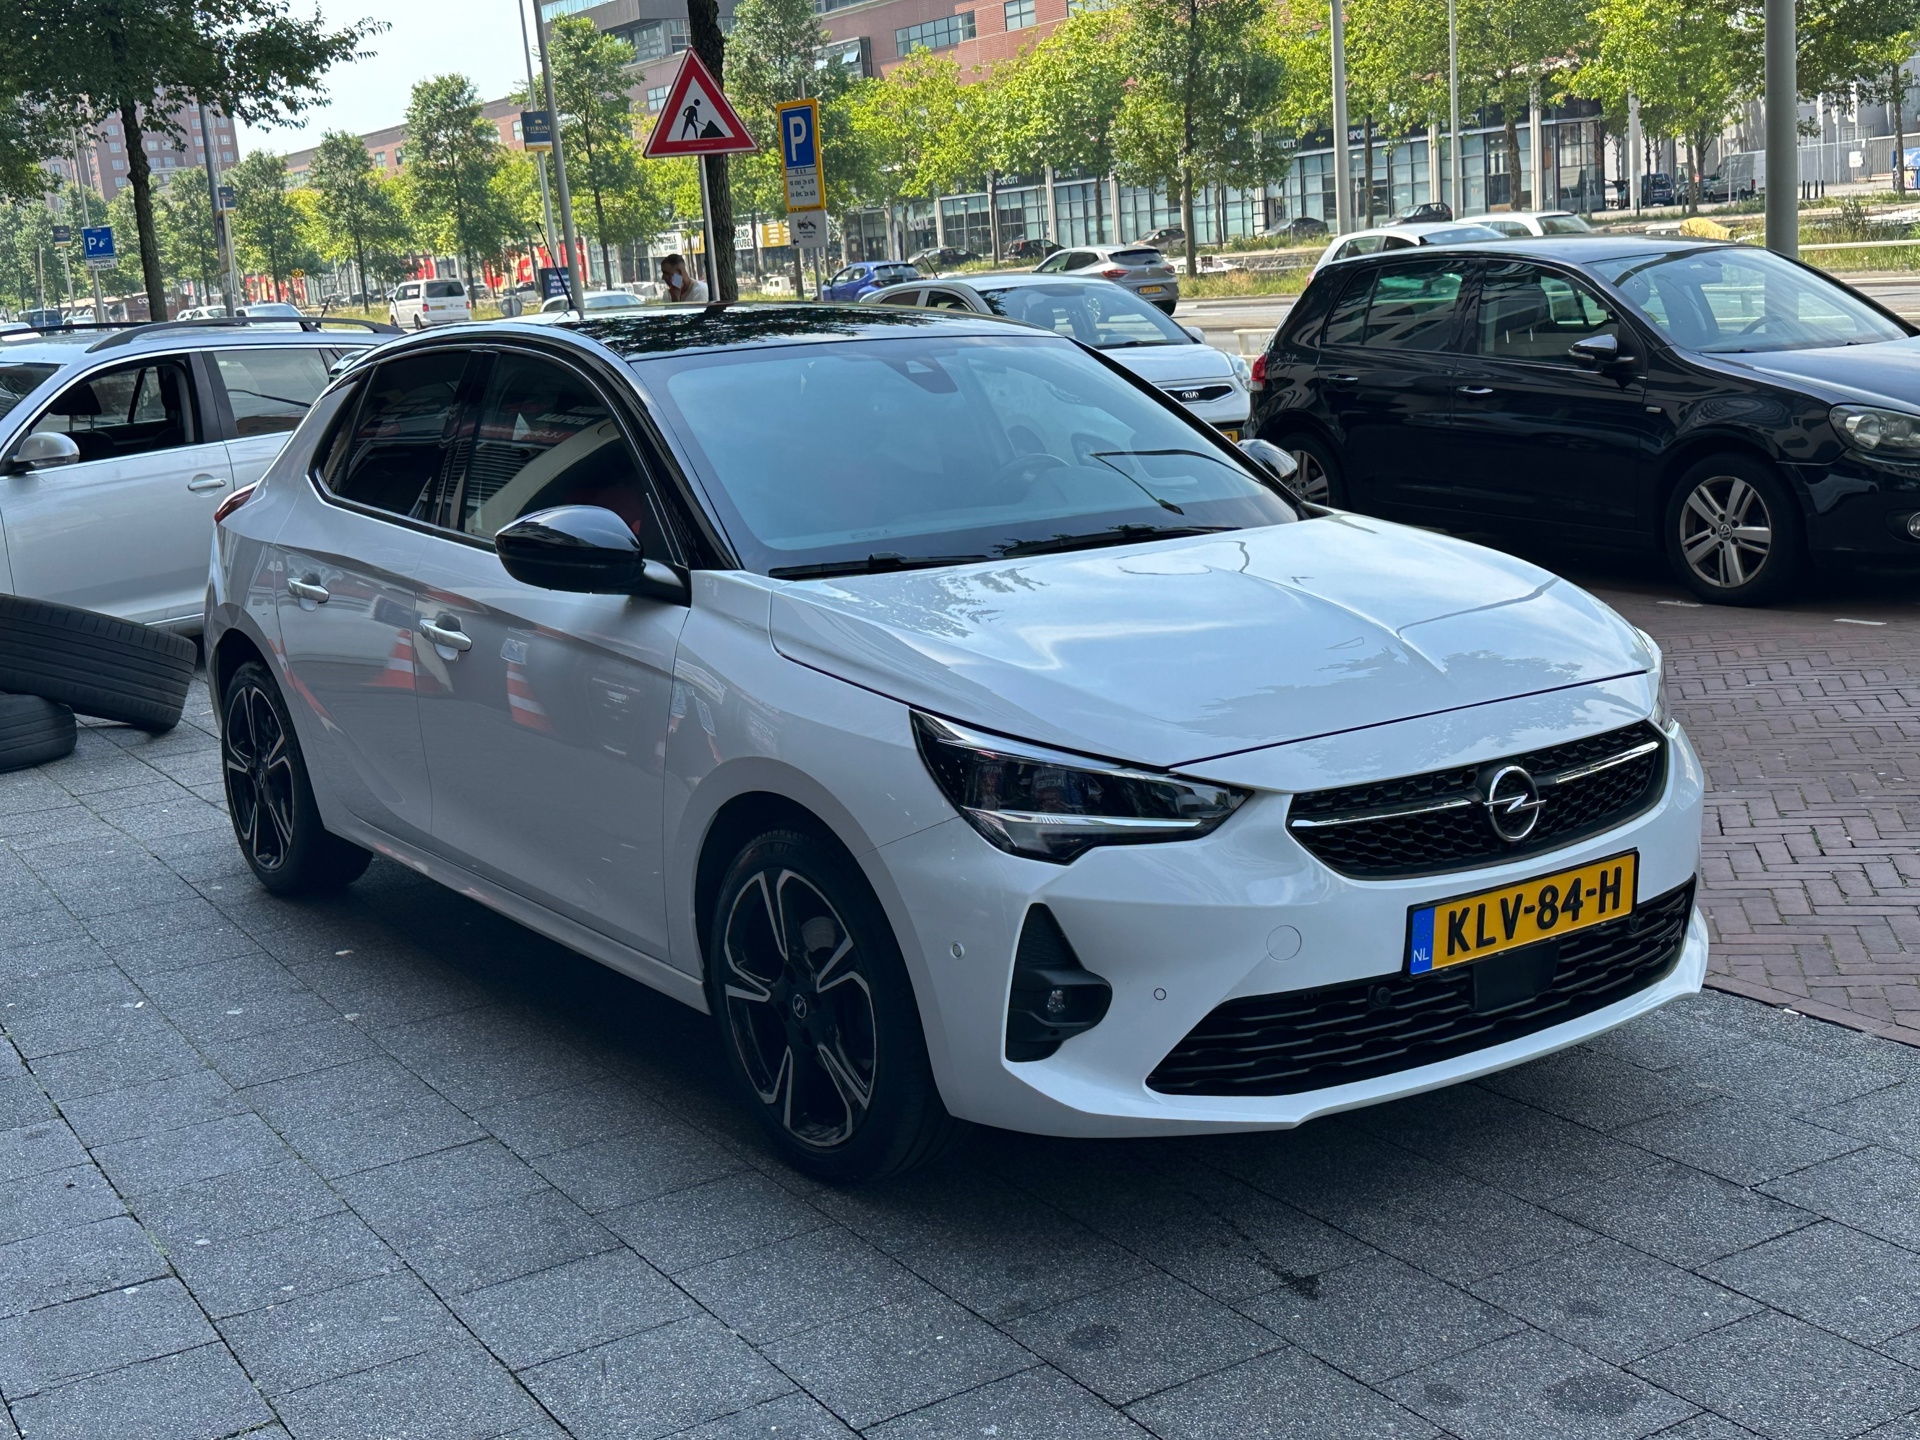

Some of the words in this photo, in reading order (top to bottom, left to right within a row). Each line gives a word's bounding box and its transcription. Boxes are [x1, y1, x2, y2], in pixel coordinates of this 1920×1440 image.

[788, 116, 807, 162] P
[87, 236, 97, 251] P
[1446, 866, 1622, 957] KLV-84-H
[1413, 947, 1430, 963] NL
